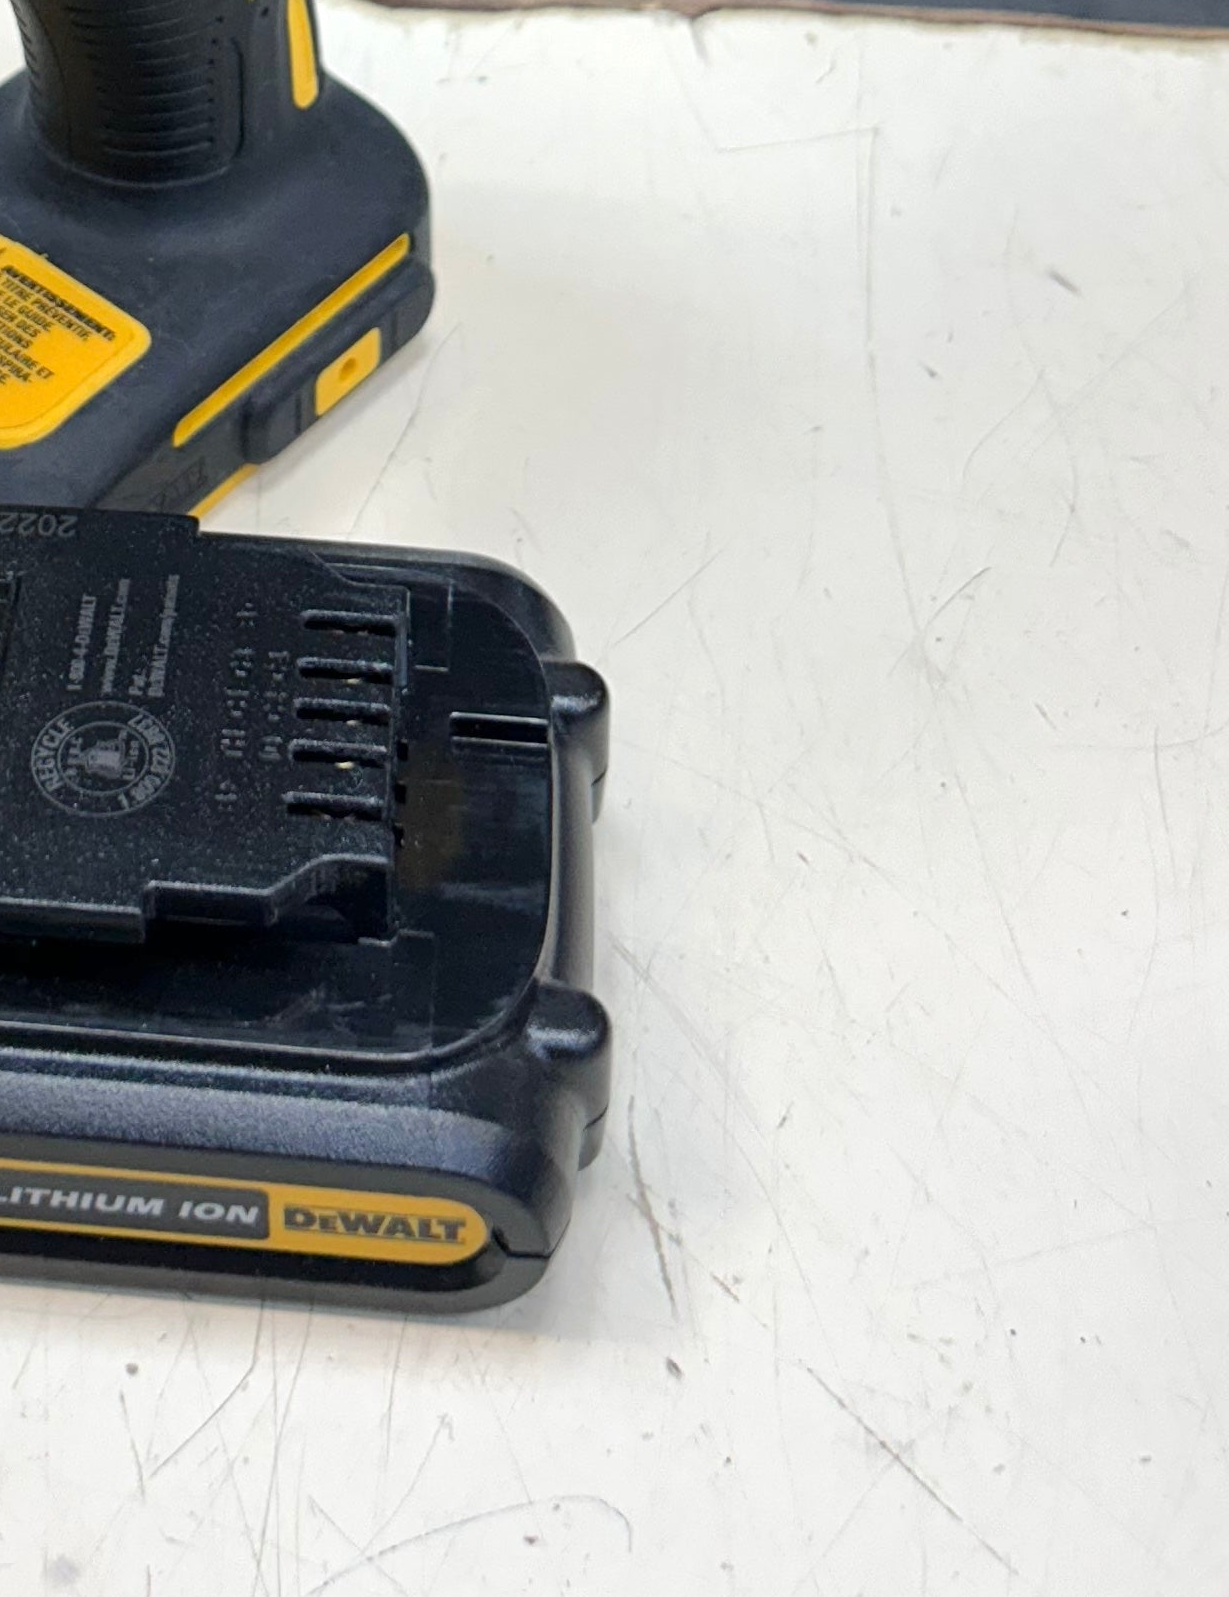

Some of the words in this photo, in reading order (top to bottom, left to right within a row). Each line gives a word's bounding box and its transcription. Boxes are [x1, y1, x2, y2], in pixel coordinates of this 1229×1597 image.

[36, 716, 75, 793] RECYCLE
[178, 1200, 260, 1226] ION
[283, 1205, 467, 1243] DEWALT
